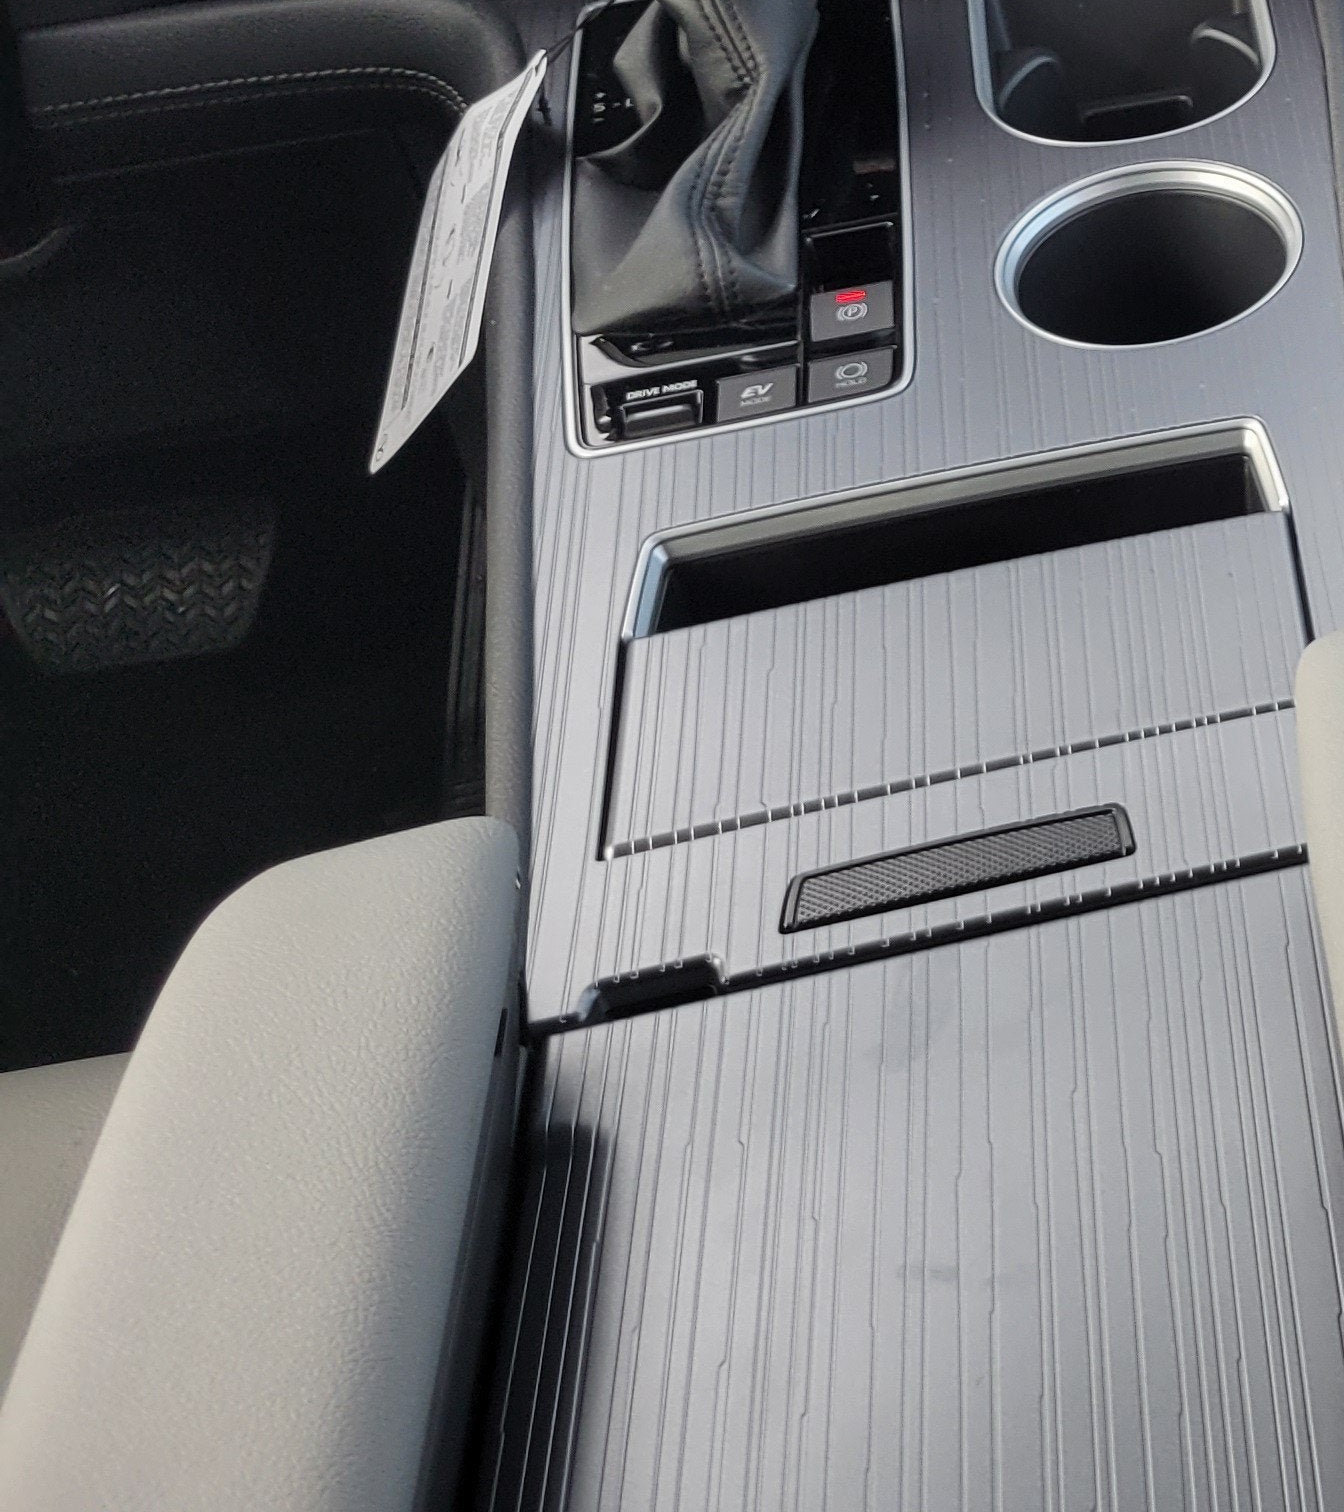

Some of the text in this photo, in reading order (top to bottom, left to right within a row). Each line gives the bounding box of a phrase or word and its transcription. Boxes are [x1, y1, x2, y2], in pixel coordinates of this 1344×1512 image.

[625, 379, 698, 401] DRIVE MODE
[740, 381, 774, 399] EV
